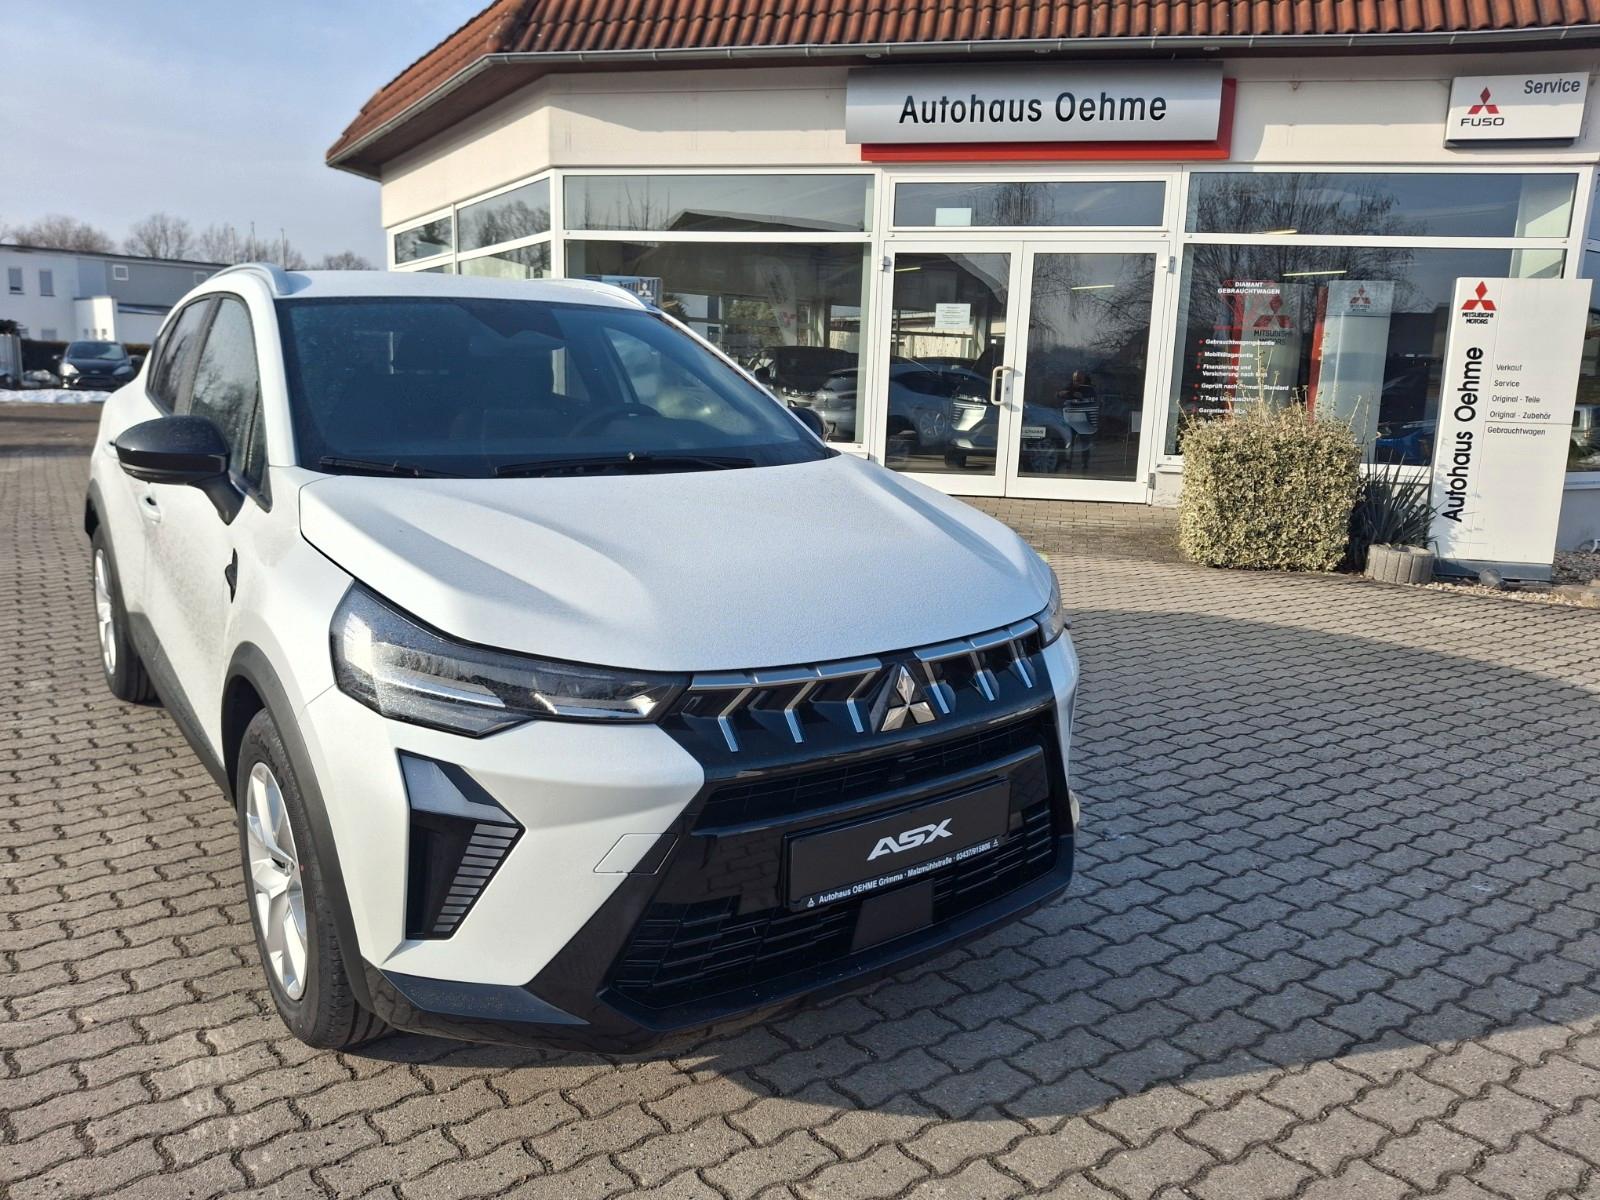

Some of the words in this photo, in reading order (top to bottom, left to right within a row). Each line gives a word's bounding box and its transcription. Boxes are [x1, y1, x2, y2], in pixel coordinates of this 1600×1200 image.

[1523, 78, 1581, 94] Service
[899, 95, 1042, 124] Autohaus
[1055, 91, 1168, 122] Oehme
[1460, 117, 1505, 127] FUSO
[1202, 363, 1239, 371] Finanzierung
[1202, 370, 1239, 378] Versicherung
[1454, 347, 1484, 422] Oehme
[1494, 379, 1520, 387] Service
[1491, 394, 1519, 404] Original
[1525, 395, 1541, 403] Teile
[1489, 410, 1517, 420] Original
[1522, 411, 1552, 420] Zubehör
[1487, 426, 1546, 436] Gebrauchtwagen
[1442, 431, 1474, 523] Autohaus
[866, 818, 953, 861] ASX
[818, 888, 851, 904] Autohaus
[852, 880, 878, 894] OEHME
[878, 873, 904, 887] Grimma
